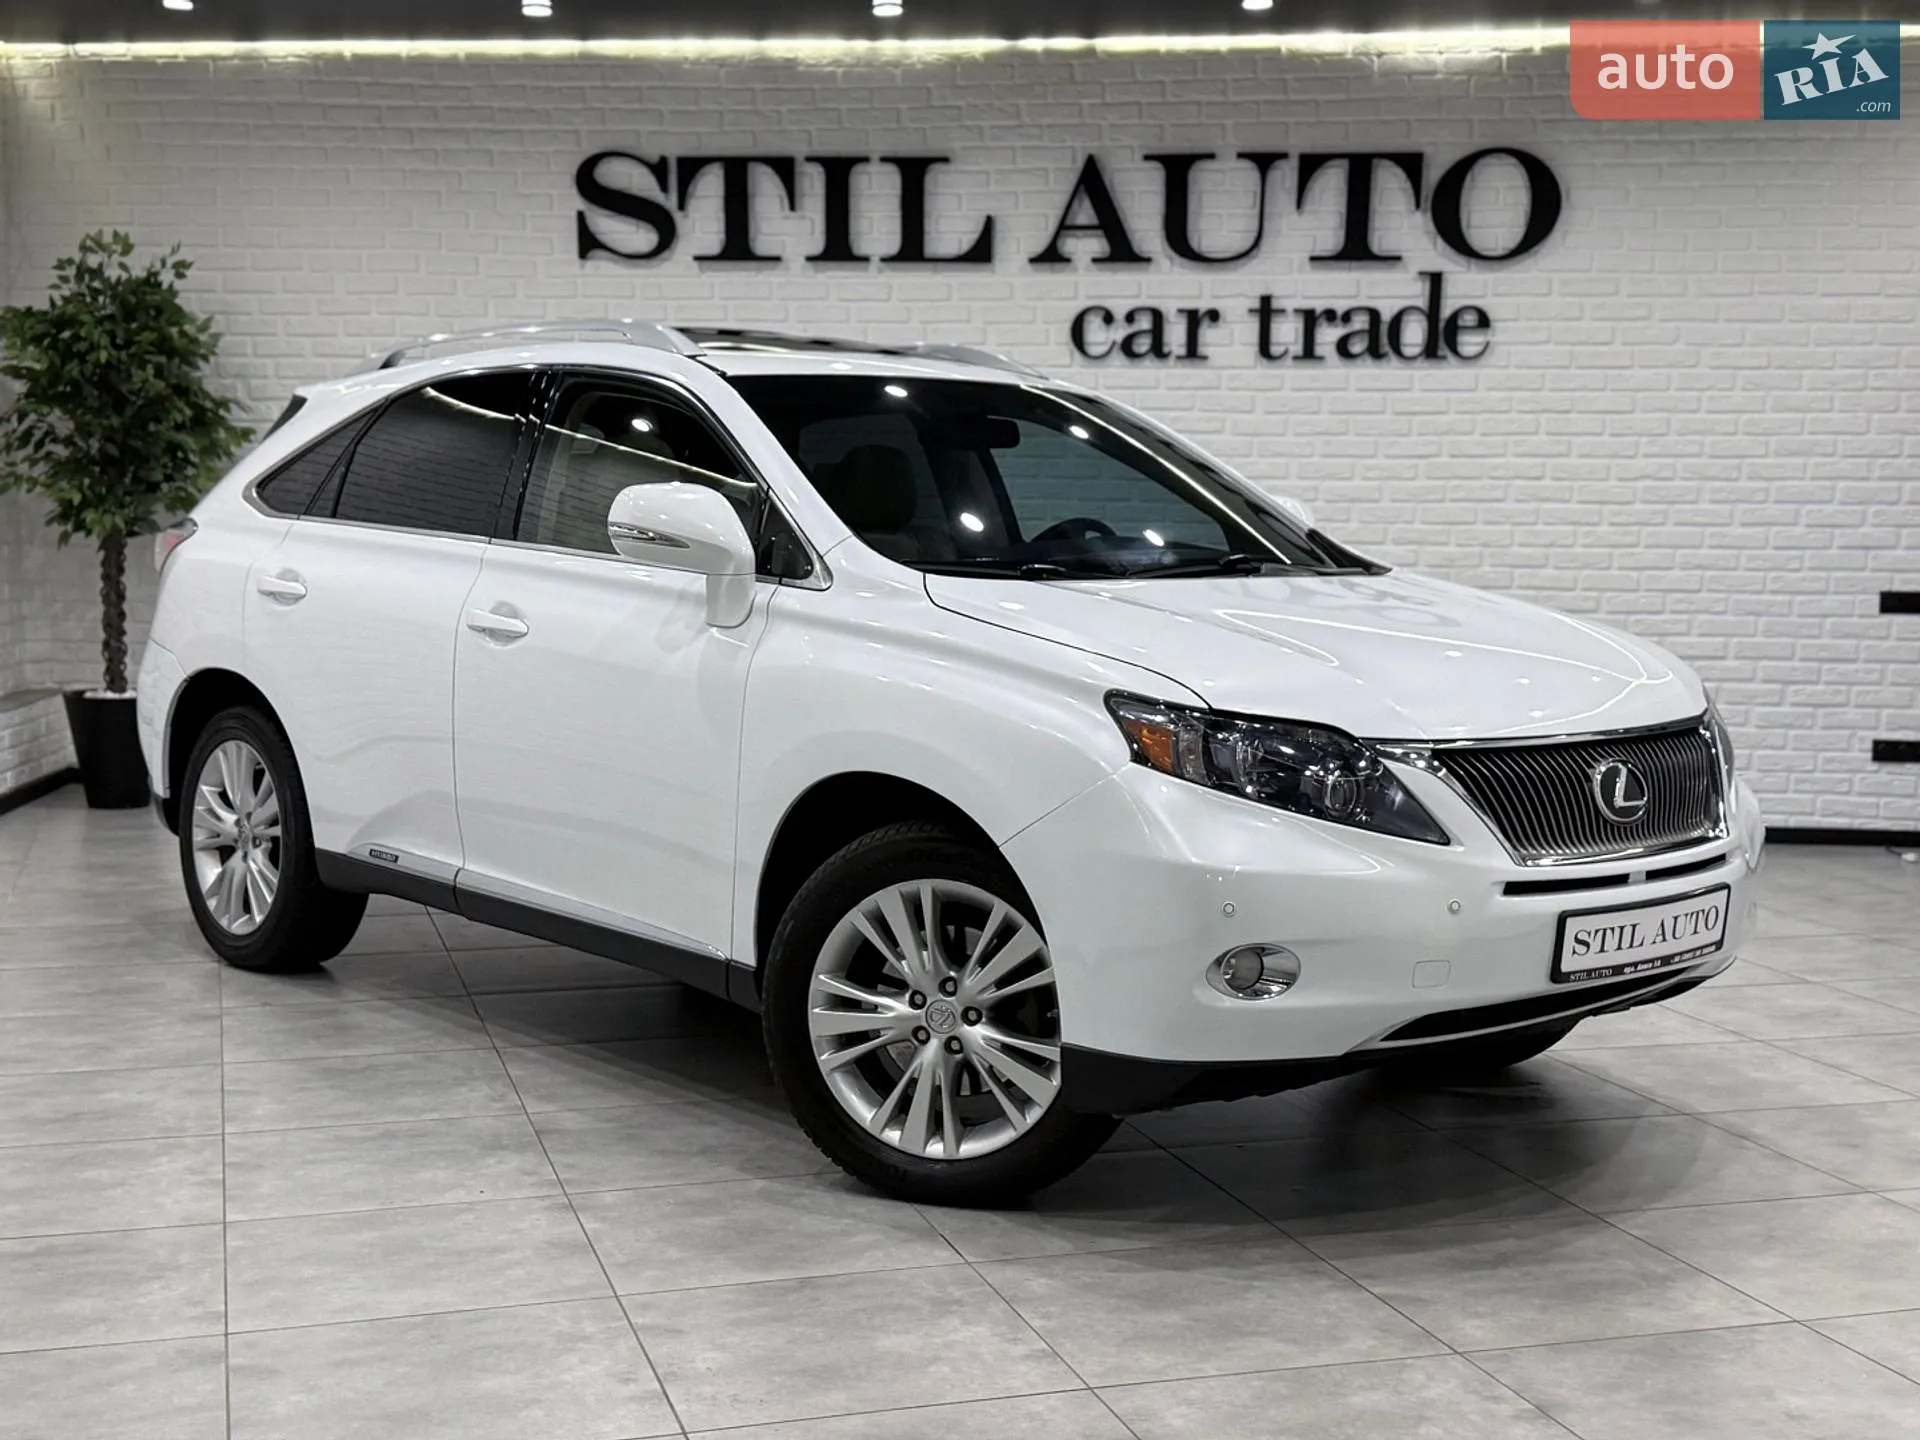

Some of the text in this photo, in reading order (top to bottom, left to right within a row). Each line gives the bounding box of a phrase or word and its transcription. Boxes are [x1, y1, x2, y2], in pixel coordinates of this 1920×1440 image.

[575, 147, 1563, 264] STIL AUTO
[1071, 272, 1491, 361] car trade
[1571, 922, 1646, 957] STIL
[1650, 904, 1720, 945] AUTO
